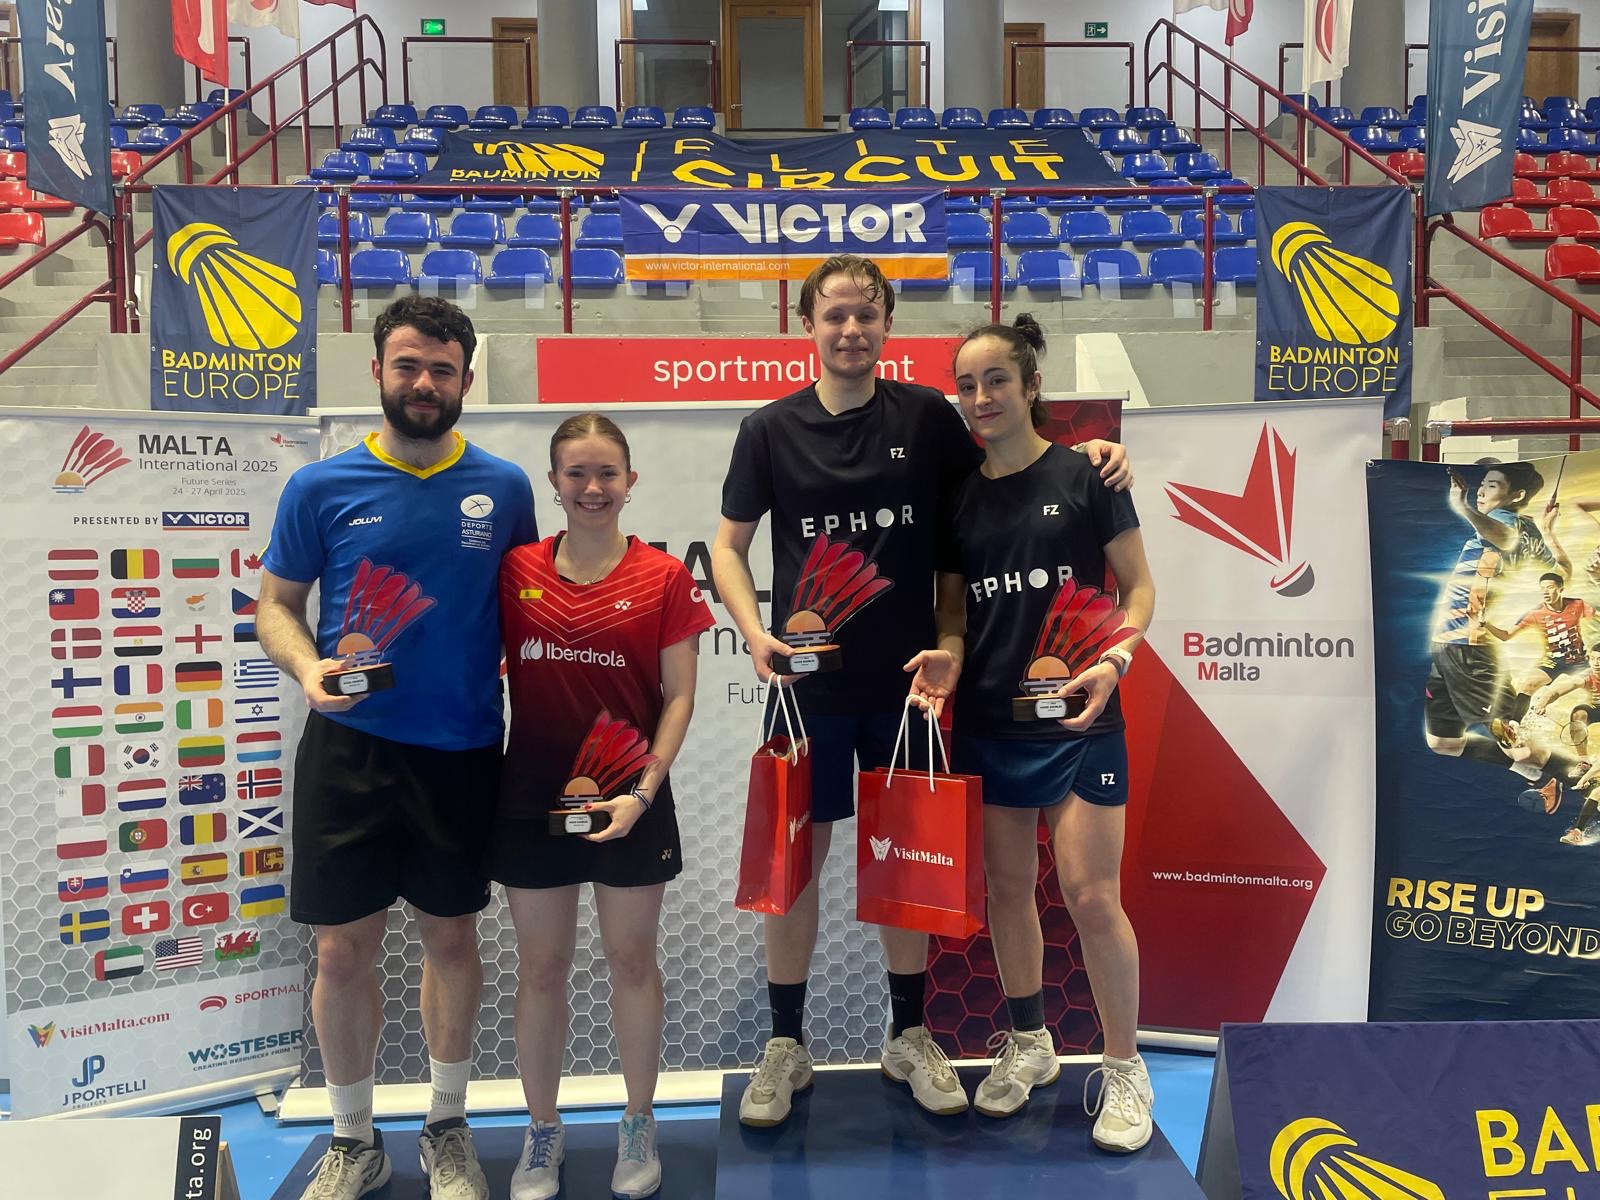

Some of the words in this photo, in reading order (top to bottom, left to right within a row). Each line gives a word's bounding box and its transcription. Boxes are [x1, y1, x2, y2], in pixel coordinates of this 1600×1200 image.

[712, 203, 927, 244] VICTOR
[645, 260, 790, 272] www.victor-international.com
[162, 349, 302, 372] BADMINTON
[1270, 345, 1399, 365] BADMINTON
[653, 354, 915, 389] sportmalmt
[1268, 364, 1398, 392] EUROPE
[163, 369, 301, 400] EUROPE
[138, 434, 233, 456] MALTA
[889, 447, 906, 459] FZ
[139, 458, 238, 472] International
[242, 460, 278, 472] 2025
[181, 477, 209, 486] Future
[211, 478, 237, 486] Series
[172, 487, 183, 495] 24
[191, 487, 202, 495] 27
[203, 487, 223, 497] April
[225, 488, 246, 496] 2025
[187, 513, 246, 525] VICTOR
[1043, 504, 1059, 516] FZ
[73, 516, 140, 525] PRESENTED
[145, 516, 159, 525] BY
[461, 521, 493, 531] DEPORTE
[546, 642, 626, 667] Iberdrola
[1183, 632, 1355, 658] Badminton
[1198, 661, 1261, 681] Malta
[1101, 773, 1115, 786] FZ
[893, 847, 954, 867] VisitMalta
[1152, 871, 1313, 890] www.badmintonmalta.org
[1386, 877, 1477, 915] RISE
[1485, 885, 1545, 920] UP
[1385, 909, 1442, 942] GO
[1446, 915, 1600, 960] BEYOND
[60, 1012, 170, 1040] VisitMalta.com
[62, 1094, 69, 1106] J
[72, 1079, 146, 1104] PORTELLI
